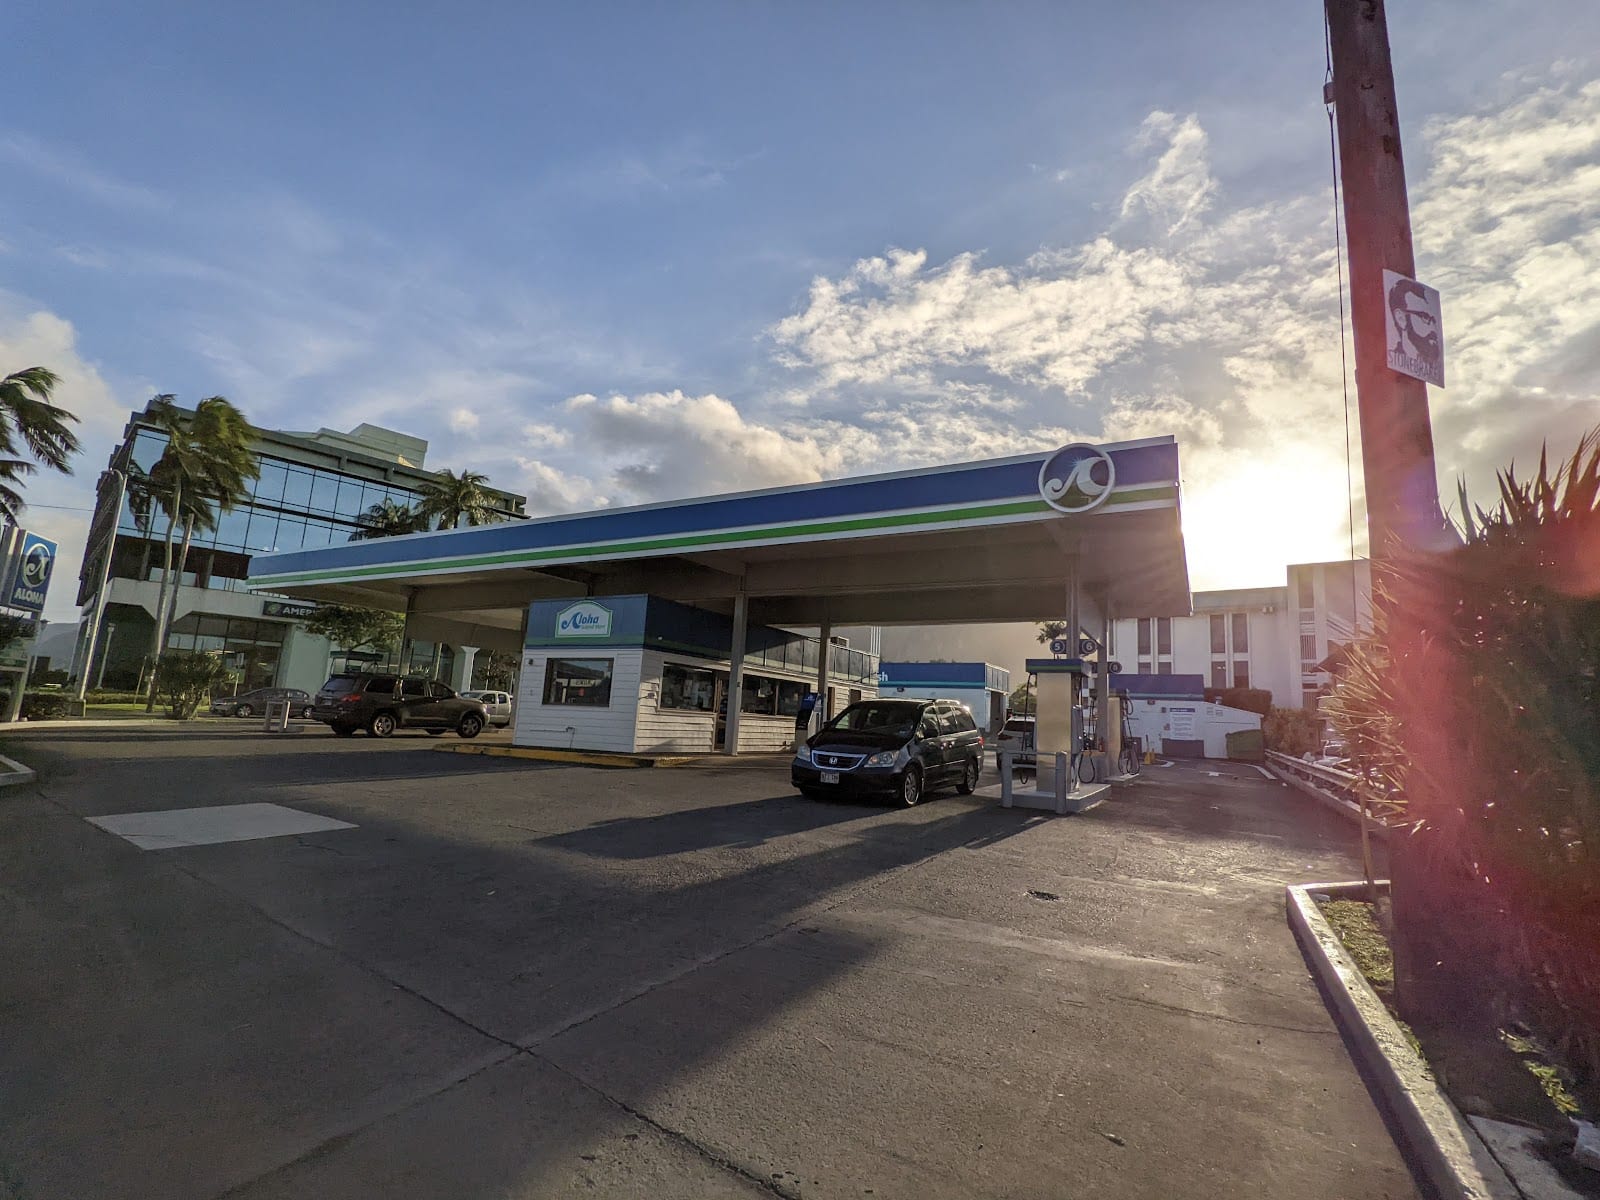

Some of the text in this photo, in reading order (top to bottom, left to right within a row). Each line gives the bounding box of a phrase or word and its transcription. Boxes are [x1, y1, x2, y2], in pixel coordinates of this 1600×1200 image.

[15, 588, 43, 604] ALOHA
[283, 607, 316, 616] AMERI
[561, 611, 599, 629] Aloha
[1086, 642, 1092, 650] 6
[878, 672, 888, 681] sh
